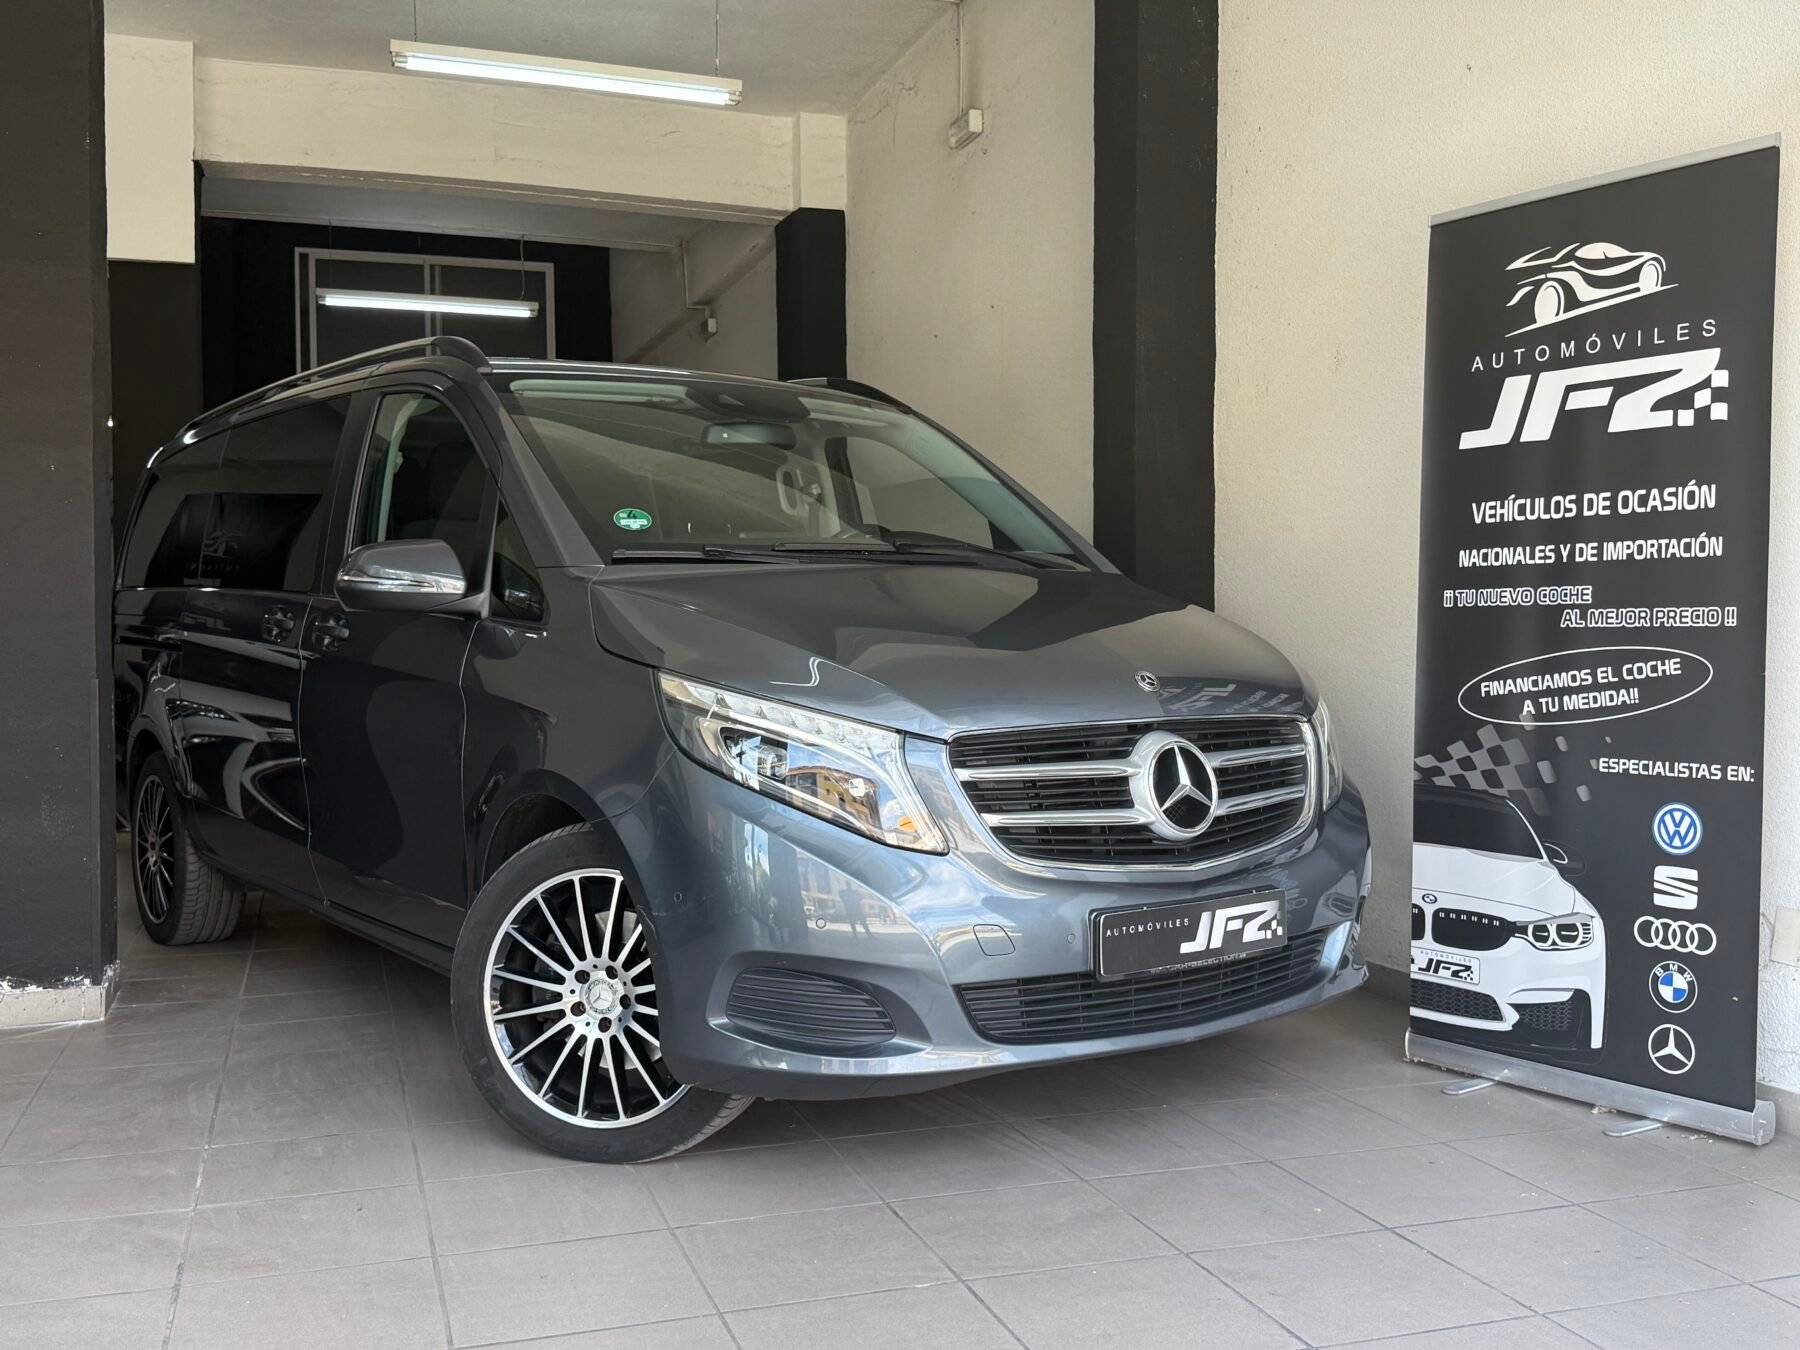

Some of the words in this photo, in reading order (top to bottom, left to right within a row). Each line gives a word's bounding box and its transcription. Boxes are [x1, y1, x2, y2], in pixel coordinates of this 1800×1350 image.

[1471, 318, 1717, 372] AUTOMÓVILES
[1458, 347, 1729, 450] JFZ
[1472, 494, 1577, 524] VEHÍCULOS
[1583, 492, 1611, 516] DE
[1617, 479, 1717, 515] OCASIÓN
[1458, 544, 1555, 568] NACIONALES
[1560, 544, 1570, 563] Y
[1575, 542, 1598, 562] DE
[1603, 531, 1723, 561] IMPORTACIÓN
[1456, 589, 1476, 607] TU
[1477, 587, 1533, 607] NUEVO
[1537, 585, 1592, 605] COCHE
[1560, 609, 1585, 627] AL
[1587, 608, 1650, 627] MEJOR
[1653, 607, 1721, 627] PRECIO
[1480, 670, 1592, 697] FINANCIAMOS
[1596, 666, 1618, 683] EL
[1622, 658, 1682, 681] COCHE
[1522, 699, 1536, 715] A
[1539, 696, 1559, 713] TU
[1563, 687, 1640, 711] MEDIDA!!
[1599, 757, 1722, 780] ESPECIALISTAS
[1726, 765, 1756, 782] EN:
[1106, 918, 1190, 937] AUTOMÓVILES
[1179, 900, 1284, 953] JFZ
[1418, 957, 1474, 981] JFZ
[1654, 963, 1693, 982] BMW
